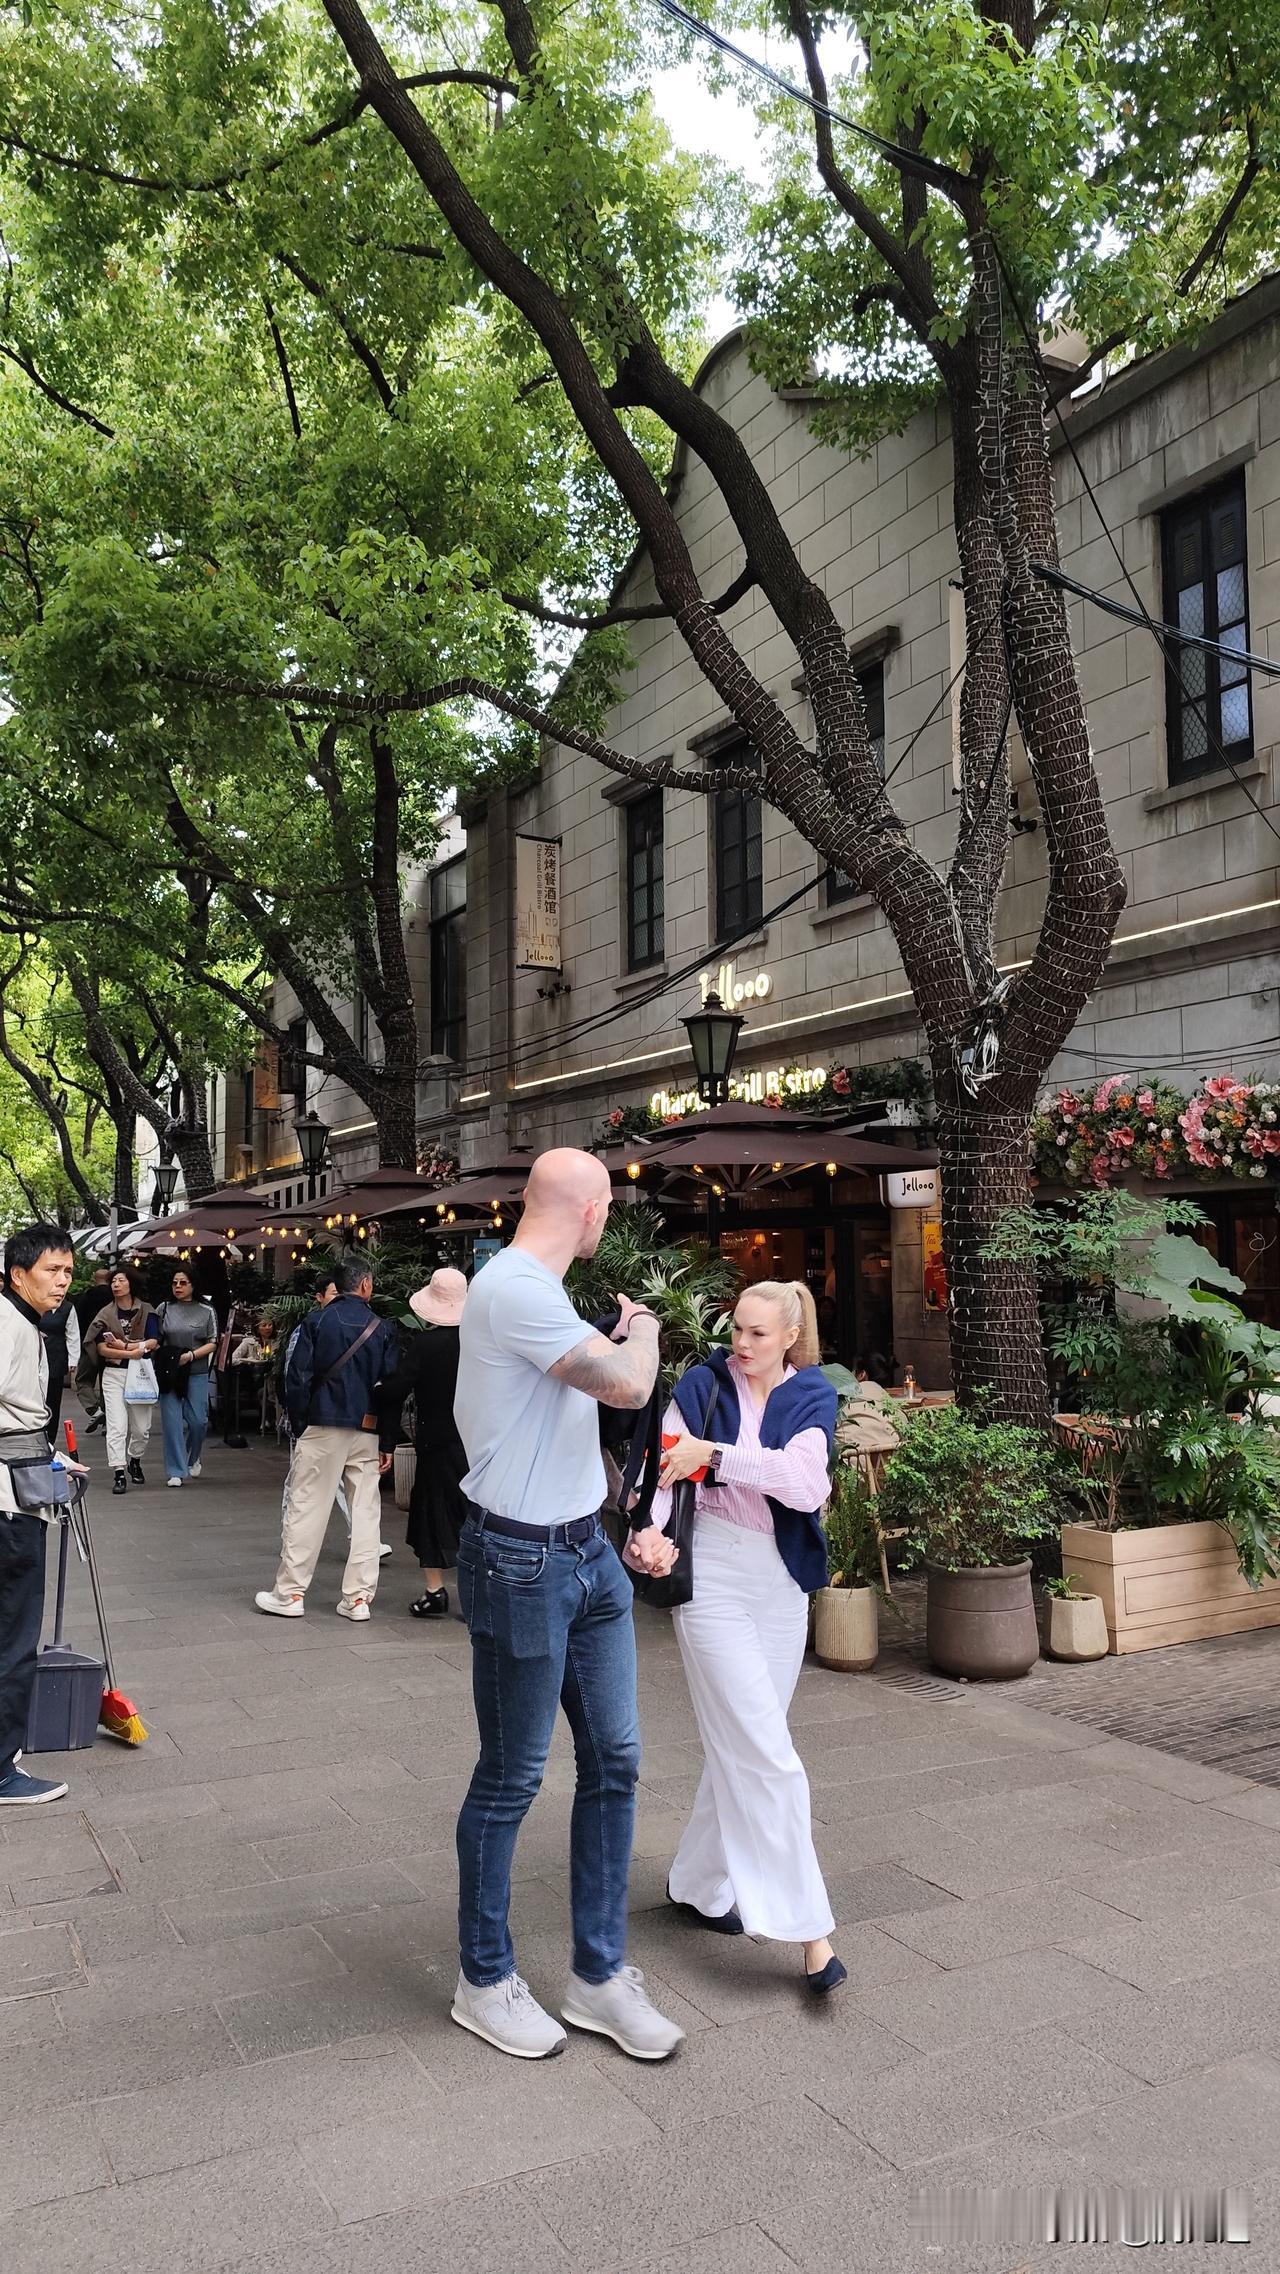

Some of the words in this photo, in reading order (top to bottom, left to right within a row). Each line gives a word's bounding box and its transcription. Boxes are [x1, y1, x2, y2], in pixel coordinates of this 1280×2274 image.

[543, 844, 557, 914] 炭烤餐酒馆
[524, 948, 554, 963] Jellooo
[699, 963, 773, 1010] Jllooo
[765, 1066, 827, 1098] Bistro
[901, 1177, 934, 1196] Jellooo
